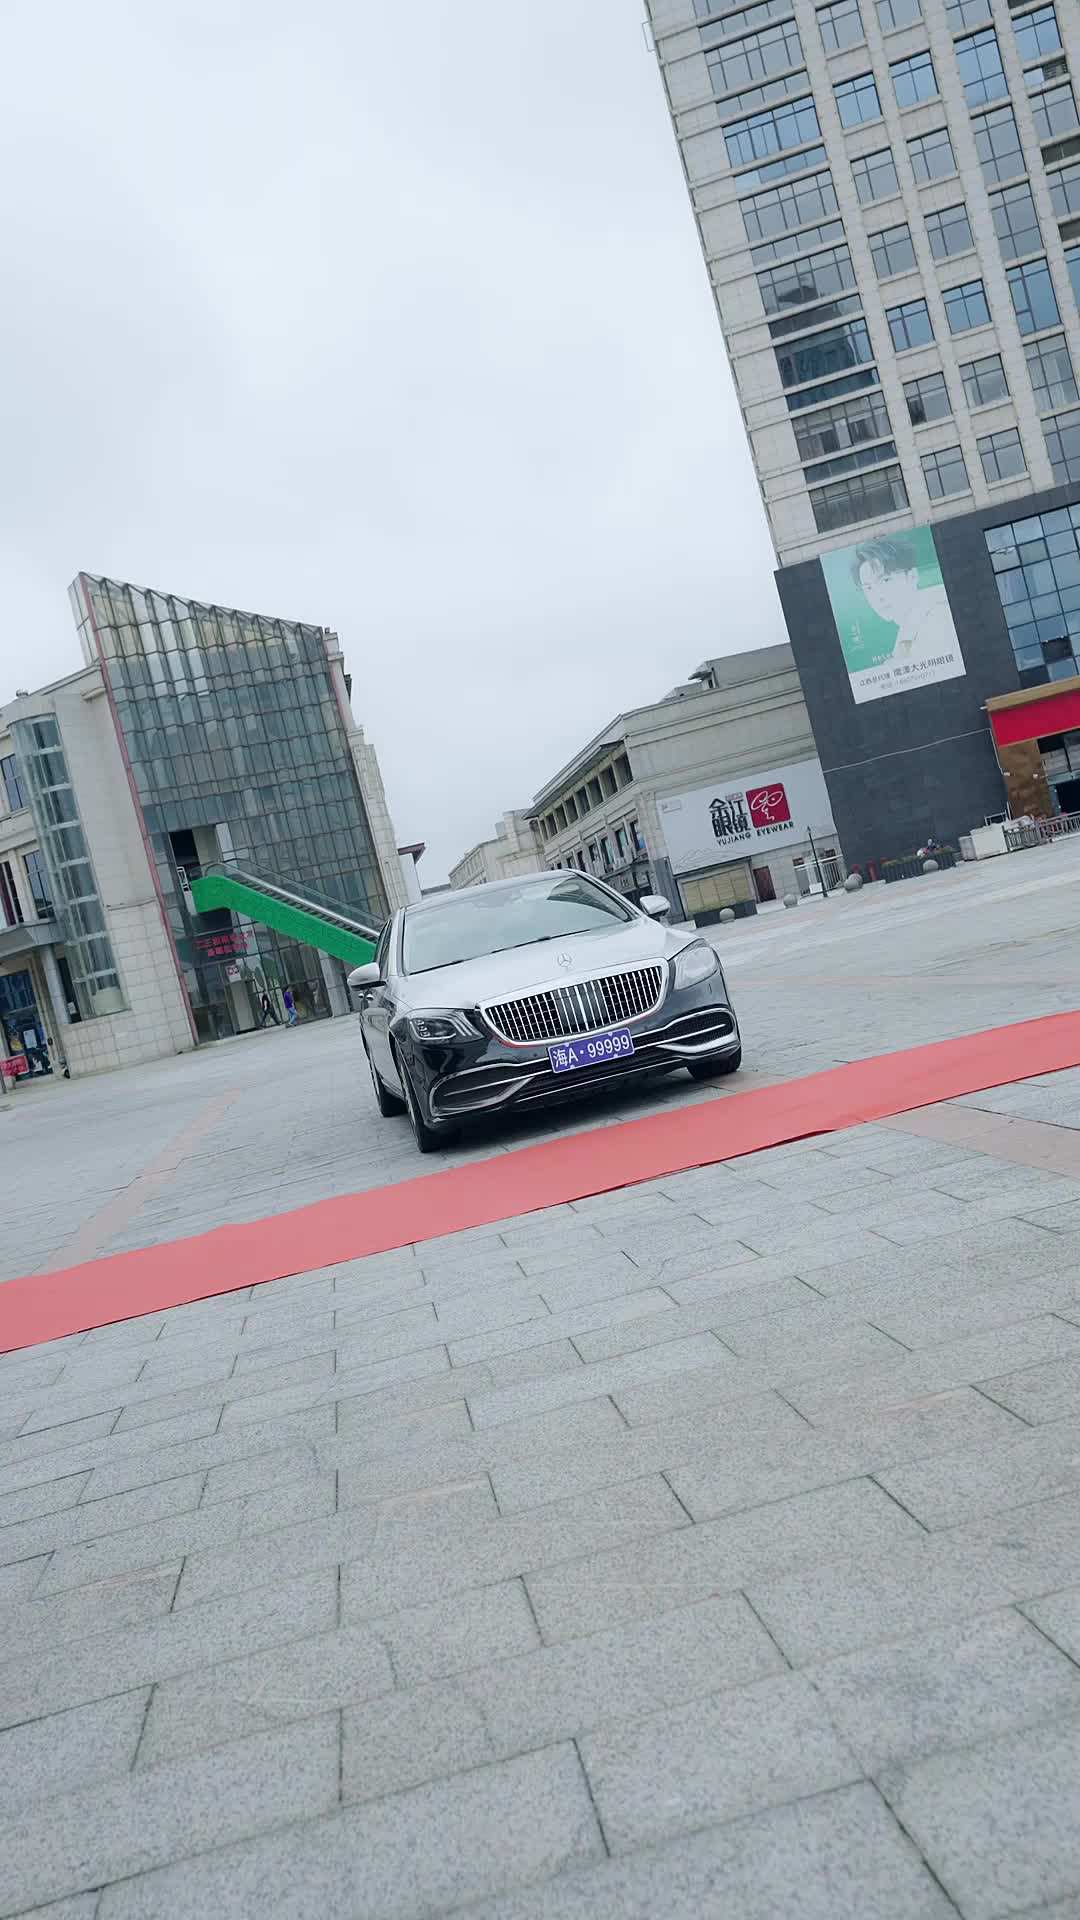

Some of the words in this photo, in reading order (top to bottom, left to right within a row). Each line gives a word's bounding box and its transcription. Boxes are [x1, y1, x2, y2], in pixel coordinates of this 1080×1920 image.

[709, 798, 748, 819] 余江
[711, 814, 751, 838] 眼镜
[716, 832, 752, 847] YUJIANG
[756, 821, 794, 838] EYEWEAR
